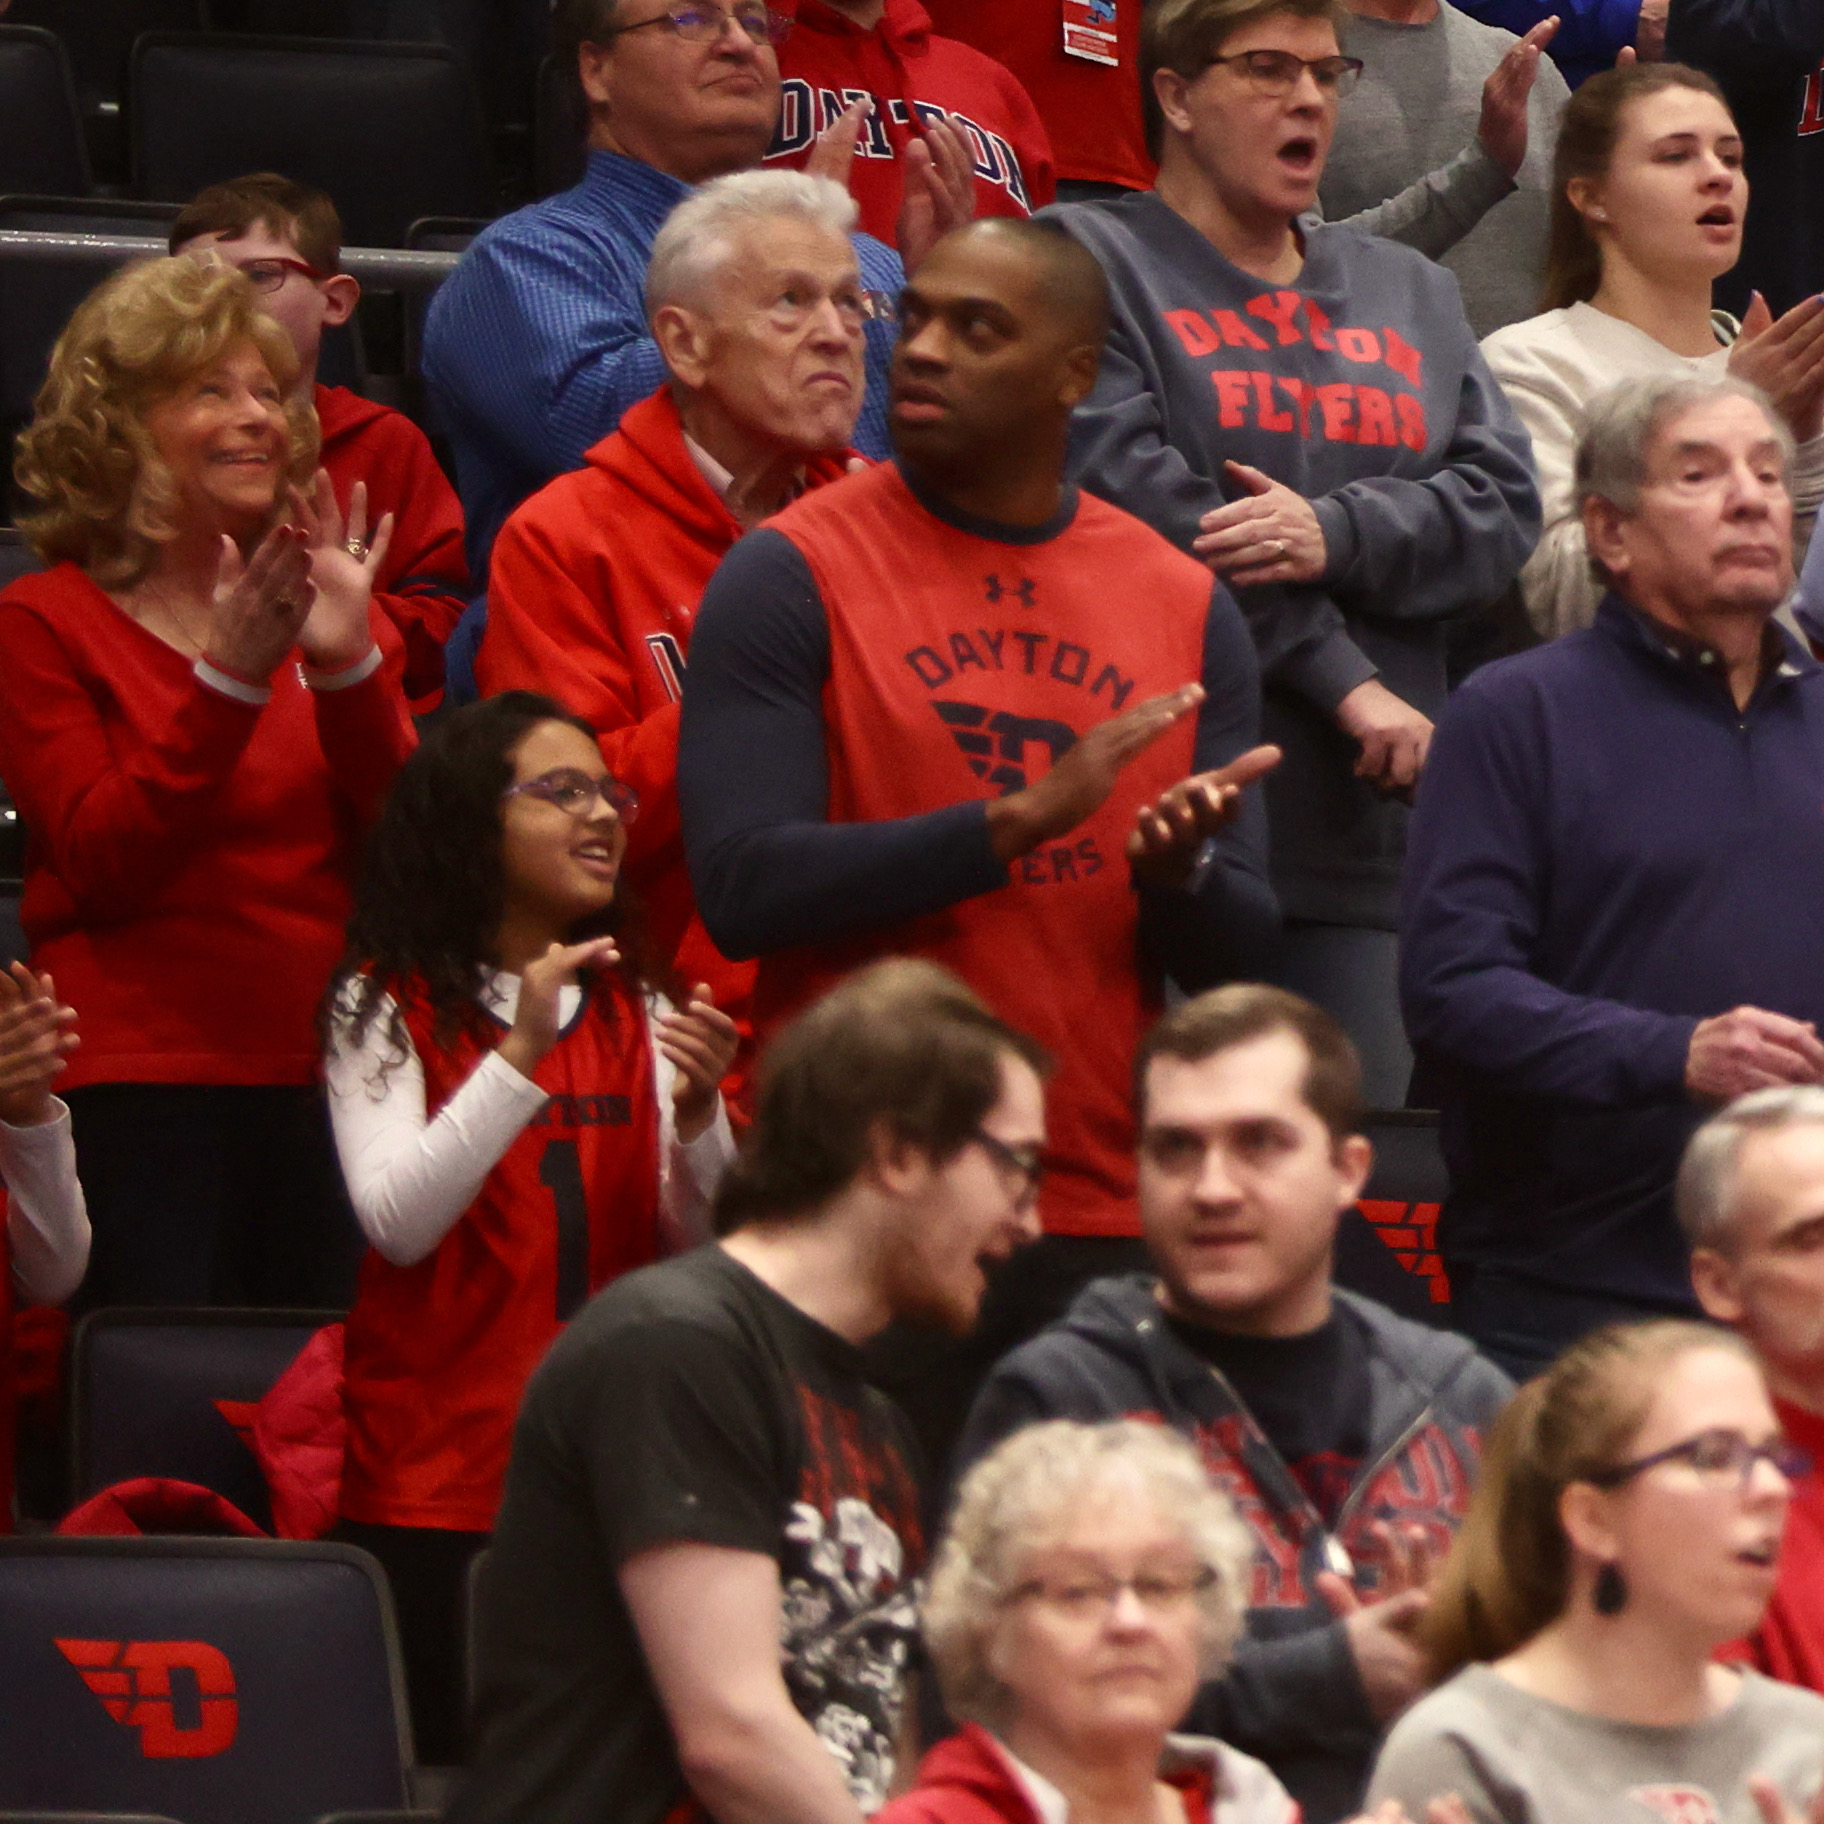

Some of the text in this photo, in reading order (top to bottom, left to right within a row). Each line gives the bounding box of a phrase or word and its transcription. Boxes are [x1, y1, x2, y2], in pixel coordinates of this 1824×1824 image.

[1162, 290, 1424, 391] DAYTON
[1210, 370, 1428, 455] FLYERS
[904, 629, 1135, 710] DAYTON
[1021, 837, 1105, 887] ERS
[539, 1139, 589, 1322] 1
